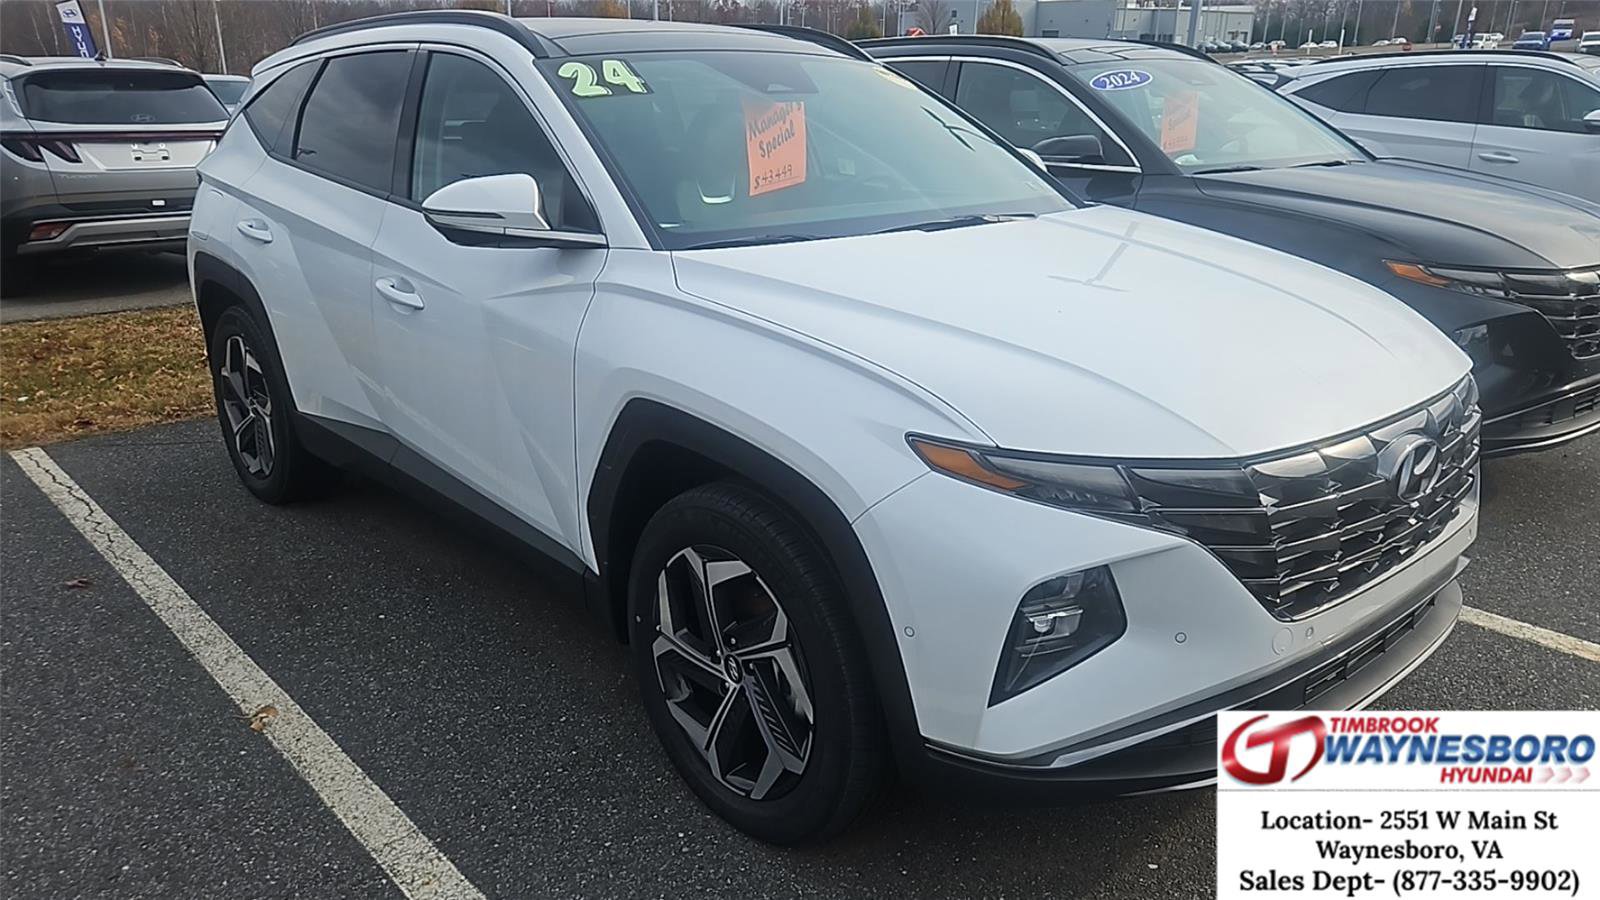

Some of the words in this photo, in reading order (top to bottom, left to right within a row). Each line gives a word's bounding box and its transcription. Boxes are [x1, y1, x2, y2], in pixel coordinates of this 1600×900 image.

[558, 59, 648, 96] 24
[1100, 71, 1141, 88] 2024
[758, 119, 796, 158] Special
